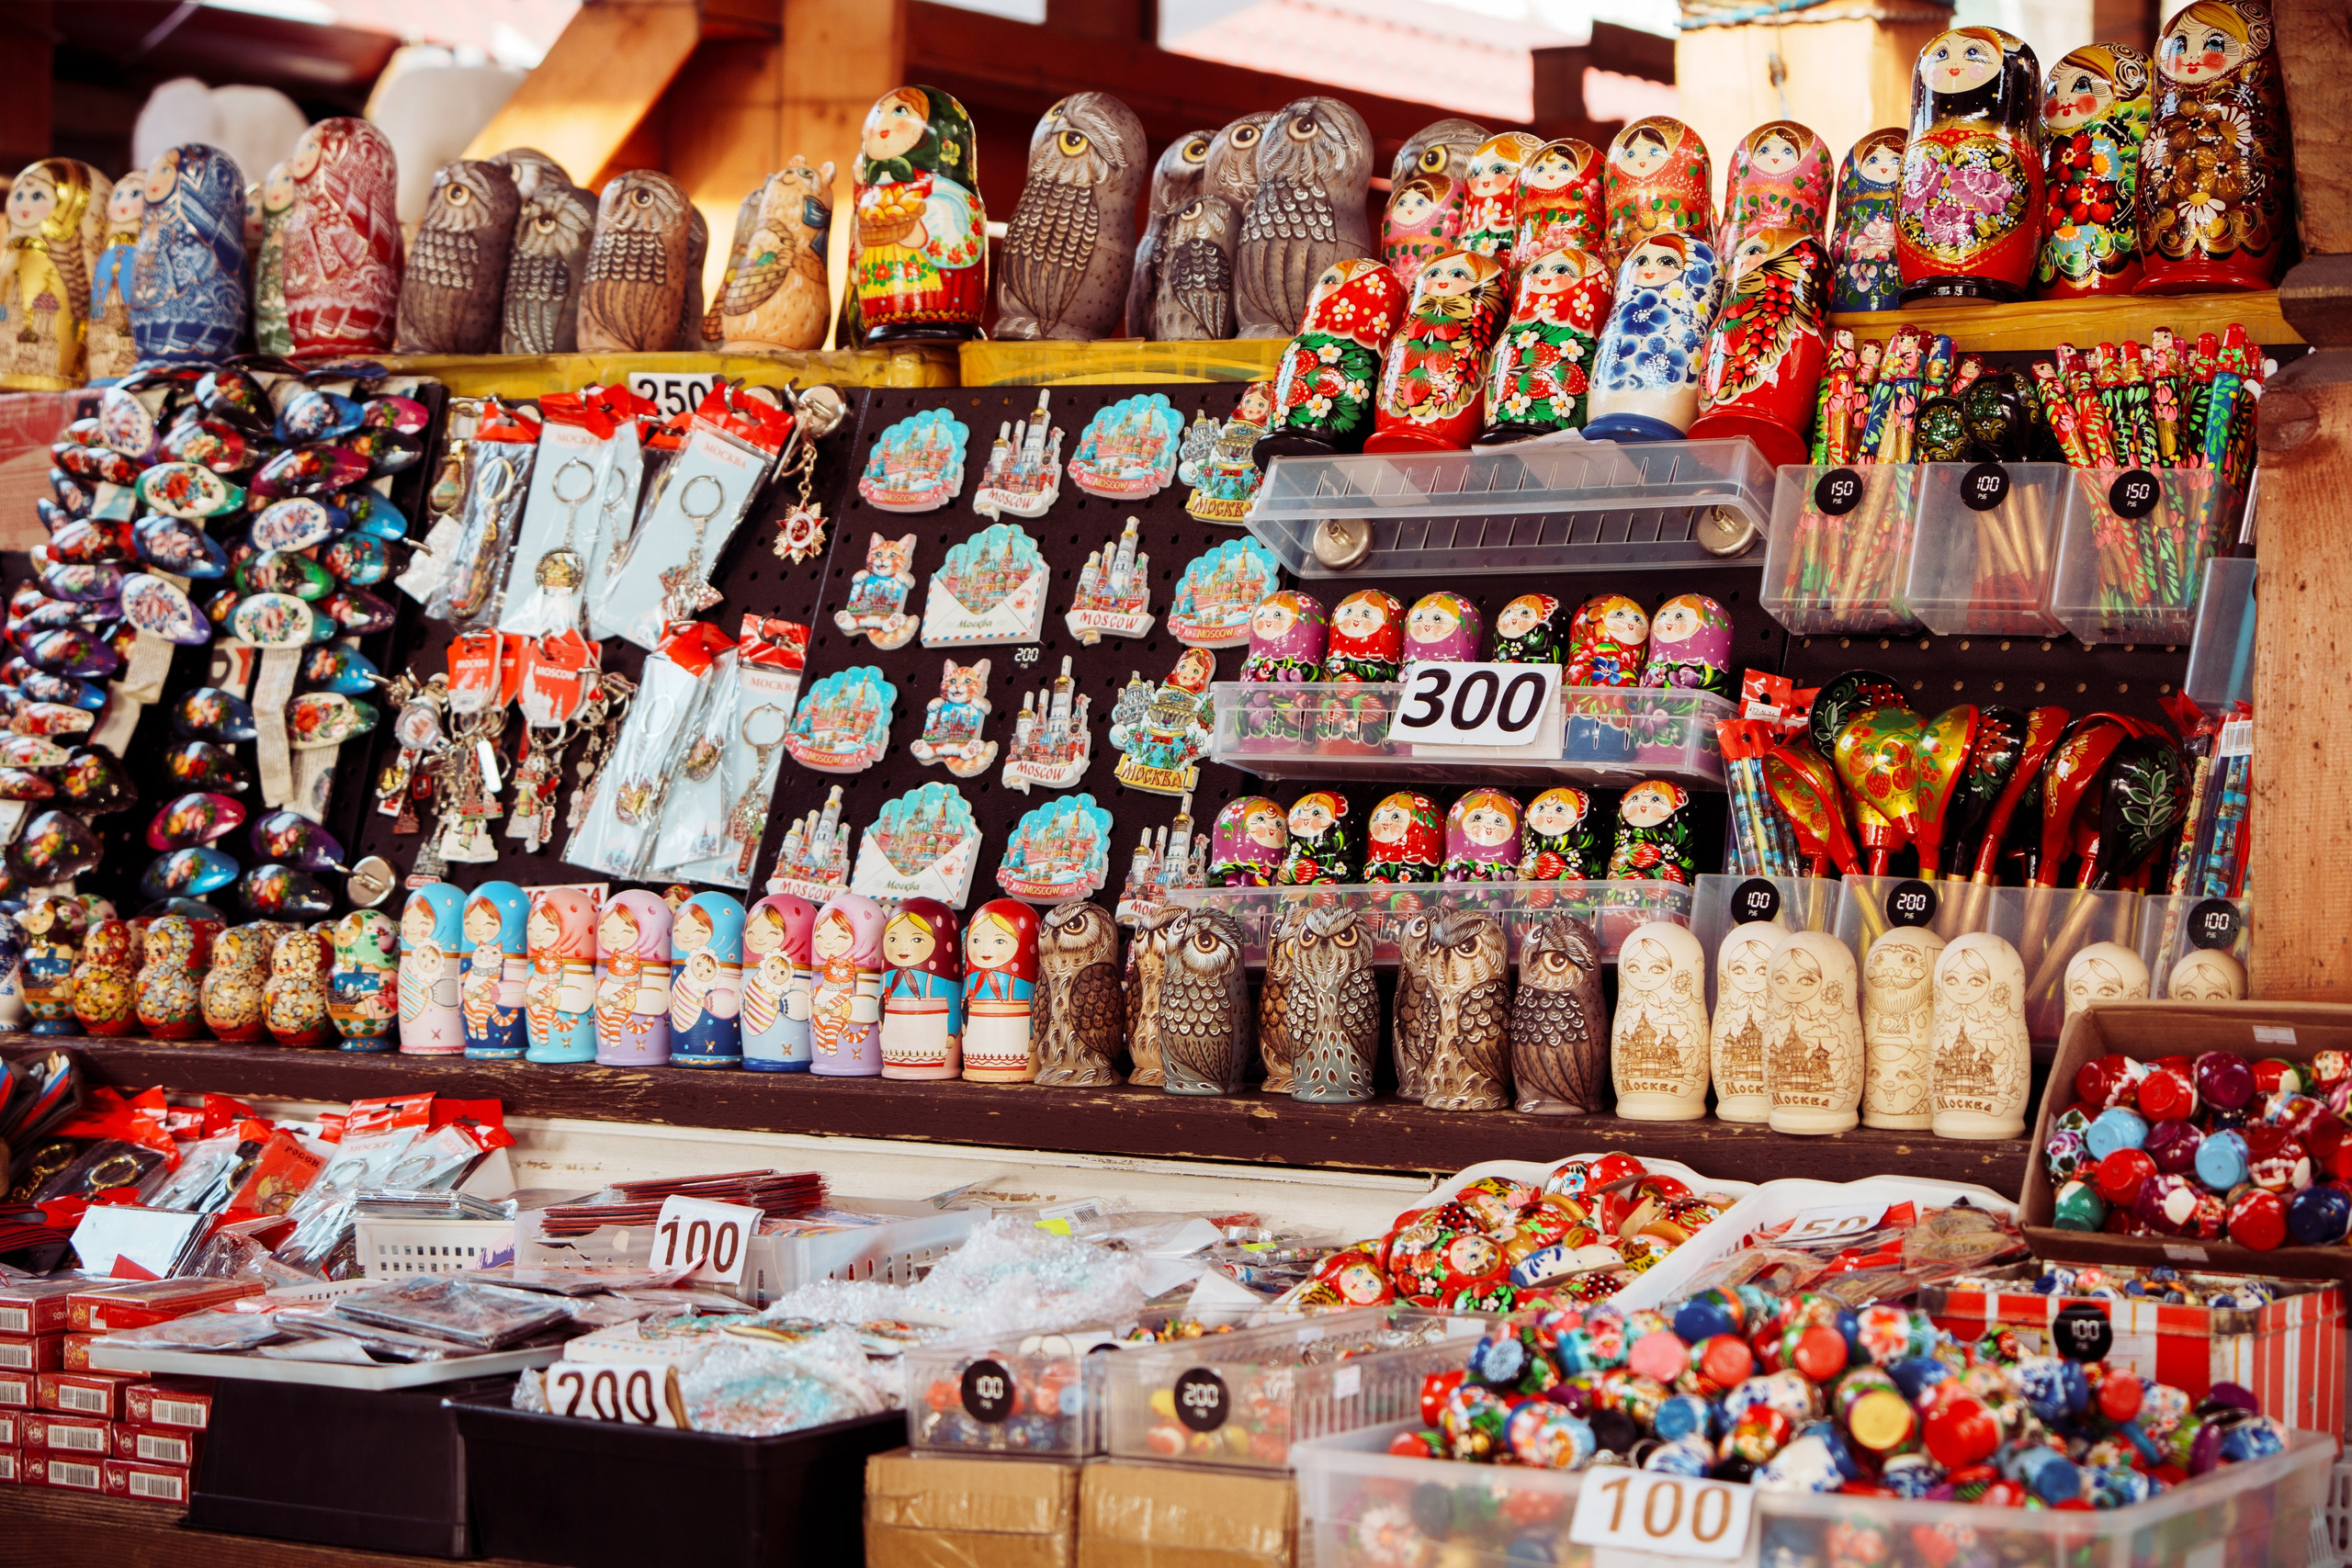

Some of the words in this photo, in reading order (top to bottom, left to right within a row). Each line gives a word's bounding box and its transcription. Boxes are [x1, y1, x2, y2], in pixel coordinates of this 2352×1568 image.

[1093, 478, 1128, 491] MOSCOW
[1830, 480, 1853, 497] 150
[1976, 475, 2000, 492] 100
[2125, 482, 2150, 500] 150
[988, 489, 1035, 510] MOSCOW
[956, 618, 993, 629] Москва
[1080, 611, 1139, 631] MOSCOW
[1197, 627, 1234, 639] MOSCOW
[1014, 648, 1040, 662] 200
[535, 665, 578, 682] MOSCOW
[1400, 668, 1547, 733] 300
[807, 752, 842, 765] MOSCOW
[1016, 761, 1066, 781] MOSCOW
[1121, 764, 1182, 788] МОСКВА
[780, 880, 837, 903] MOSCOW
[885, 879, 921, 891] Москва
[1023, 884, 1061, 896] MOSCOW
[1747, 891, 1770, 909] 100
[1896, 893, 1927, 912] 200
[2205, 911, 2230, 931] 100
[1725, 1082, 1764, 1096] Моск
[1792, 1215, 1869, 1237] 50
[661, 1214, 740, 1274] 100
[2071, 1318, 2100, 1341] 100
[557, 1369, 658, 1424] 200
[976, 1375, 1004, 1400] 100
[1182, 1382, 1219, 1408] 200
[1600, 1474, 1732, 1544] 100
